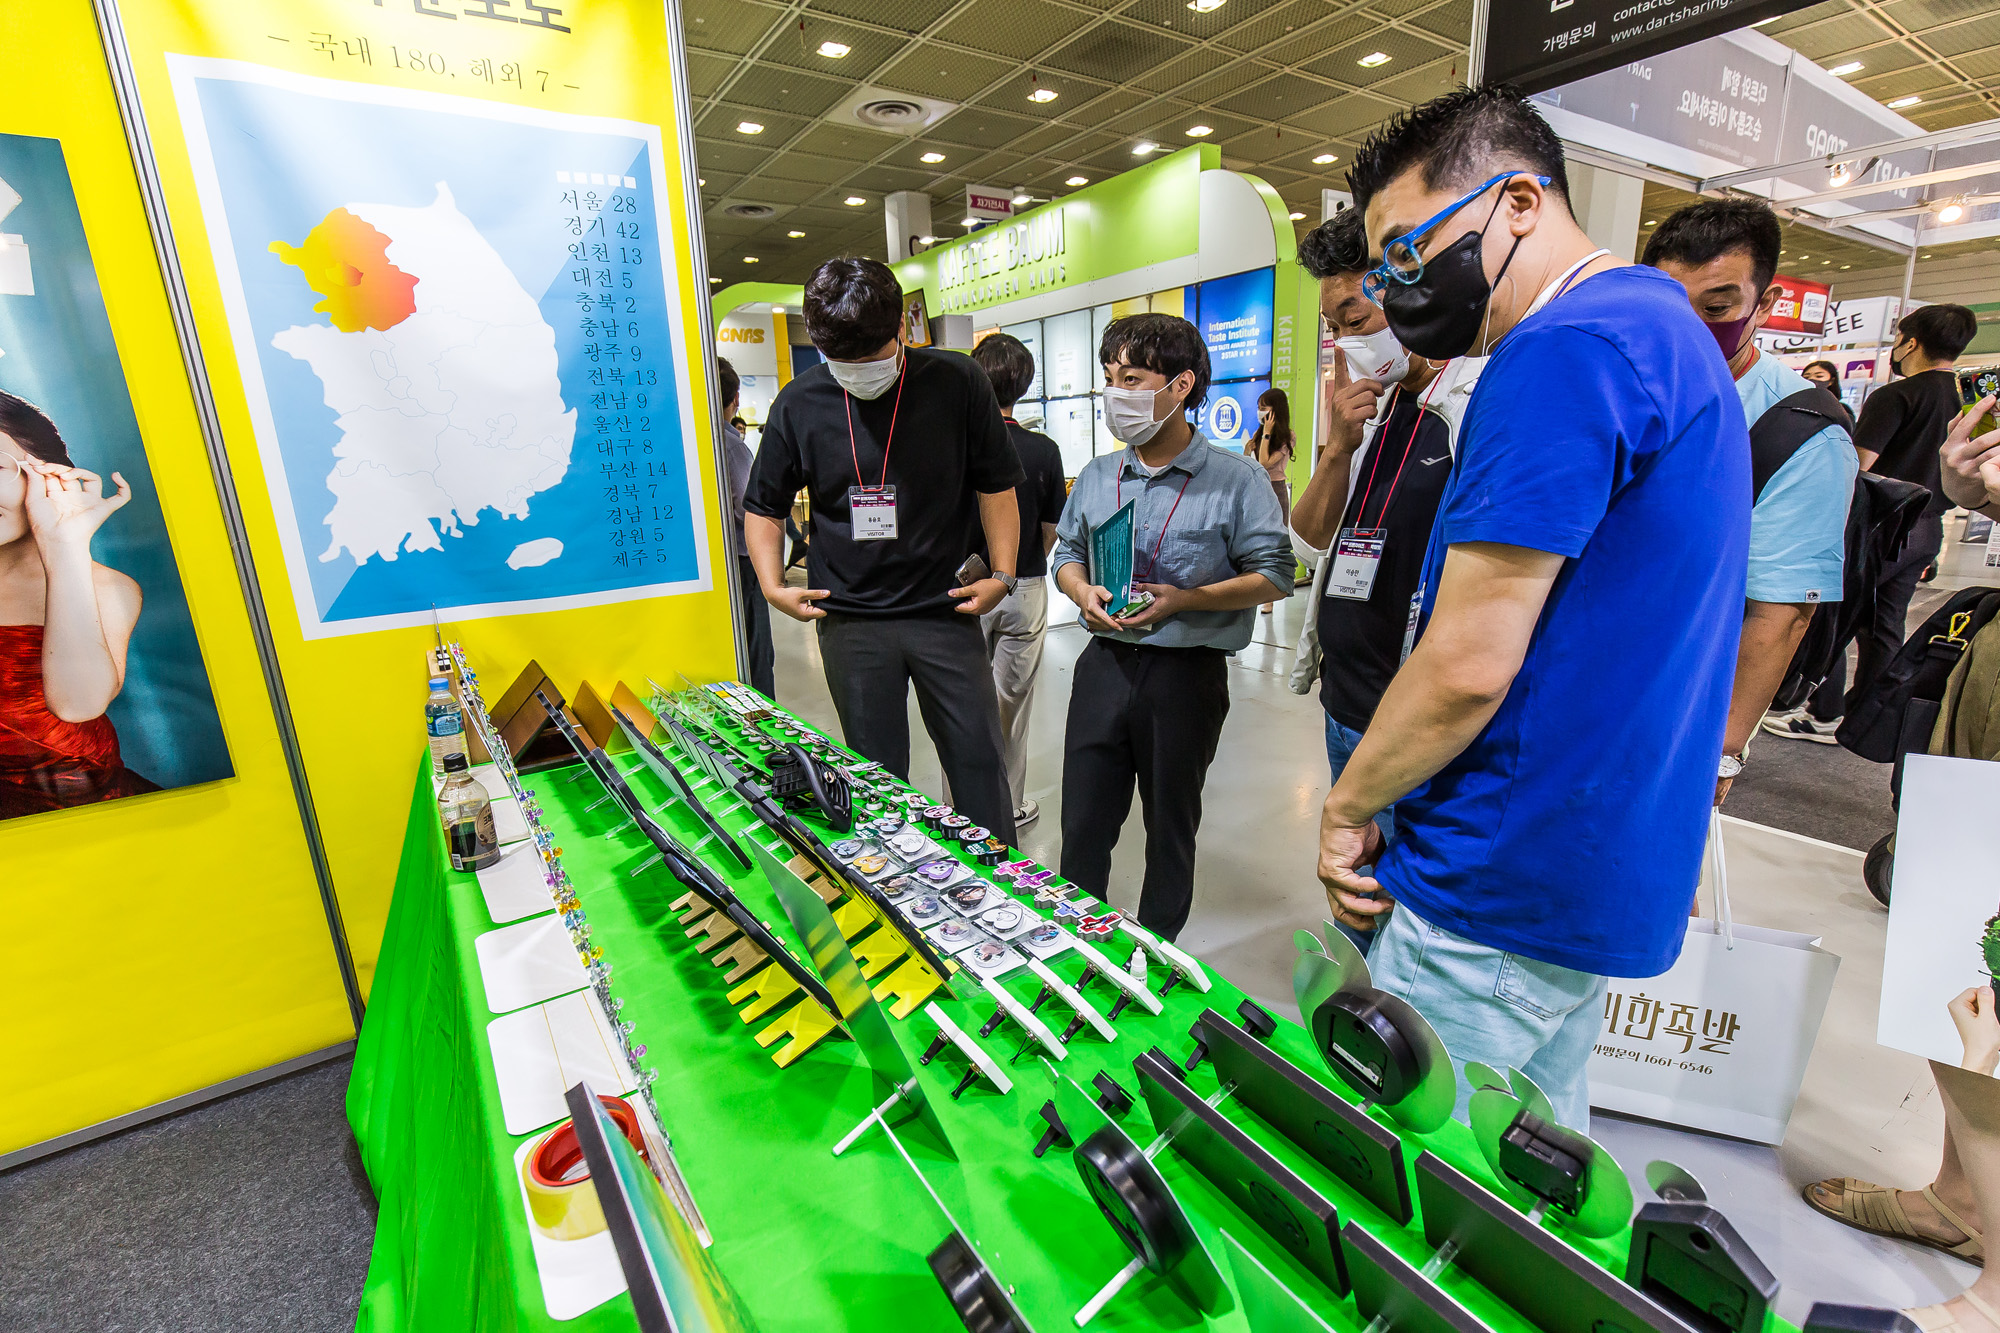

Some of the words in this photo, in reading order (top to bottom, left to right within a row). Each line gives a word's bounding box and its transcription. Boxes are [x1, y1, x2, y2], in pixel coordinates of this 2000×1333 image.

[1543, 21, 1596, 52] 가맹문의
[308, 31, 371, 66] 국내
[391, 46, 455, 78] 180,
[469, 58, 522, 90] 해외
[536, 70, 549, 92] 7
[560, 189, 603, 212] 서울
[612, 195, 637, 214] 28
[564, 216, 605, 238] 경기
[616, 221, 640, 240] 42
[567, 241, 610, 263] 인천
[620, 247, 643, 265] 13
[937, 231, 1000, 292] KAFFEE
[1005, 207, 1066, 271] BAUM
[572, 267, 613, 288] 대전
[622, 272, 633, 289] 5
[1029, 263, 1066, 290] HAUS
[575, 291, 617, 314] 충북
[625, 296, 637, 314] 2
[579, 317, 620, 338] 충남
[628, 321, 639, 338] 6
[1208, 315, 1257, 332] International
[1208, 333, 1227, 343] Taste
[1228, 327, 1260, 340] Institute
[1277, 315, 1293, 374] KAFFEE
[584, 342, 623, 363] 광주
[631, 345, 642, 362] 9
[1221, 350, 1238, 360] 3STAR
[587, 366, 626, 387] 전북
[635, 369, 657, 386] 13
[590, 391, 629, 410] 전남
[636, 393, 648, 409] 9
[593, 414, 632, 434] 울산
[640, 416, 651, 432] 2
[1219, 422, 1232, 430] 2022
[596, 438, 635, 457] 대구
[643, 439, 654, 454] 8
[600, 460, 638, 480] 부산
[647, 461, 668, 477] 14
[603, 483, 640, 503] 경북
[648, 484, 658, 499] 7
[606, 505, 644, 525] 경남
[652, 505, 674, 521] 12
[609, 527, 646, 547] 강원
[654, 528, 664, 542] 5
[612, 549, 648, 569] 제주
[655, 549, 667, 563] 5
[1644, 1054, 1714, 1075] 1661-6546
